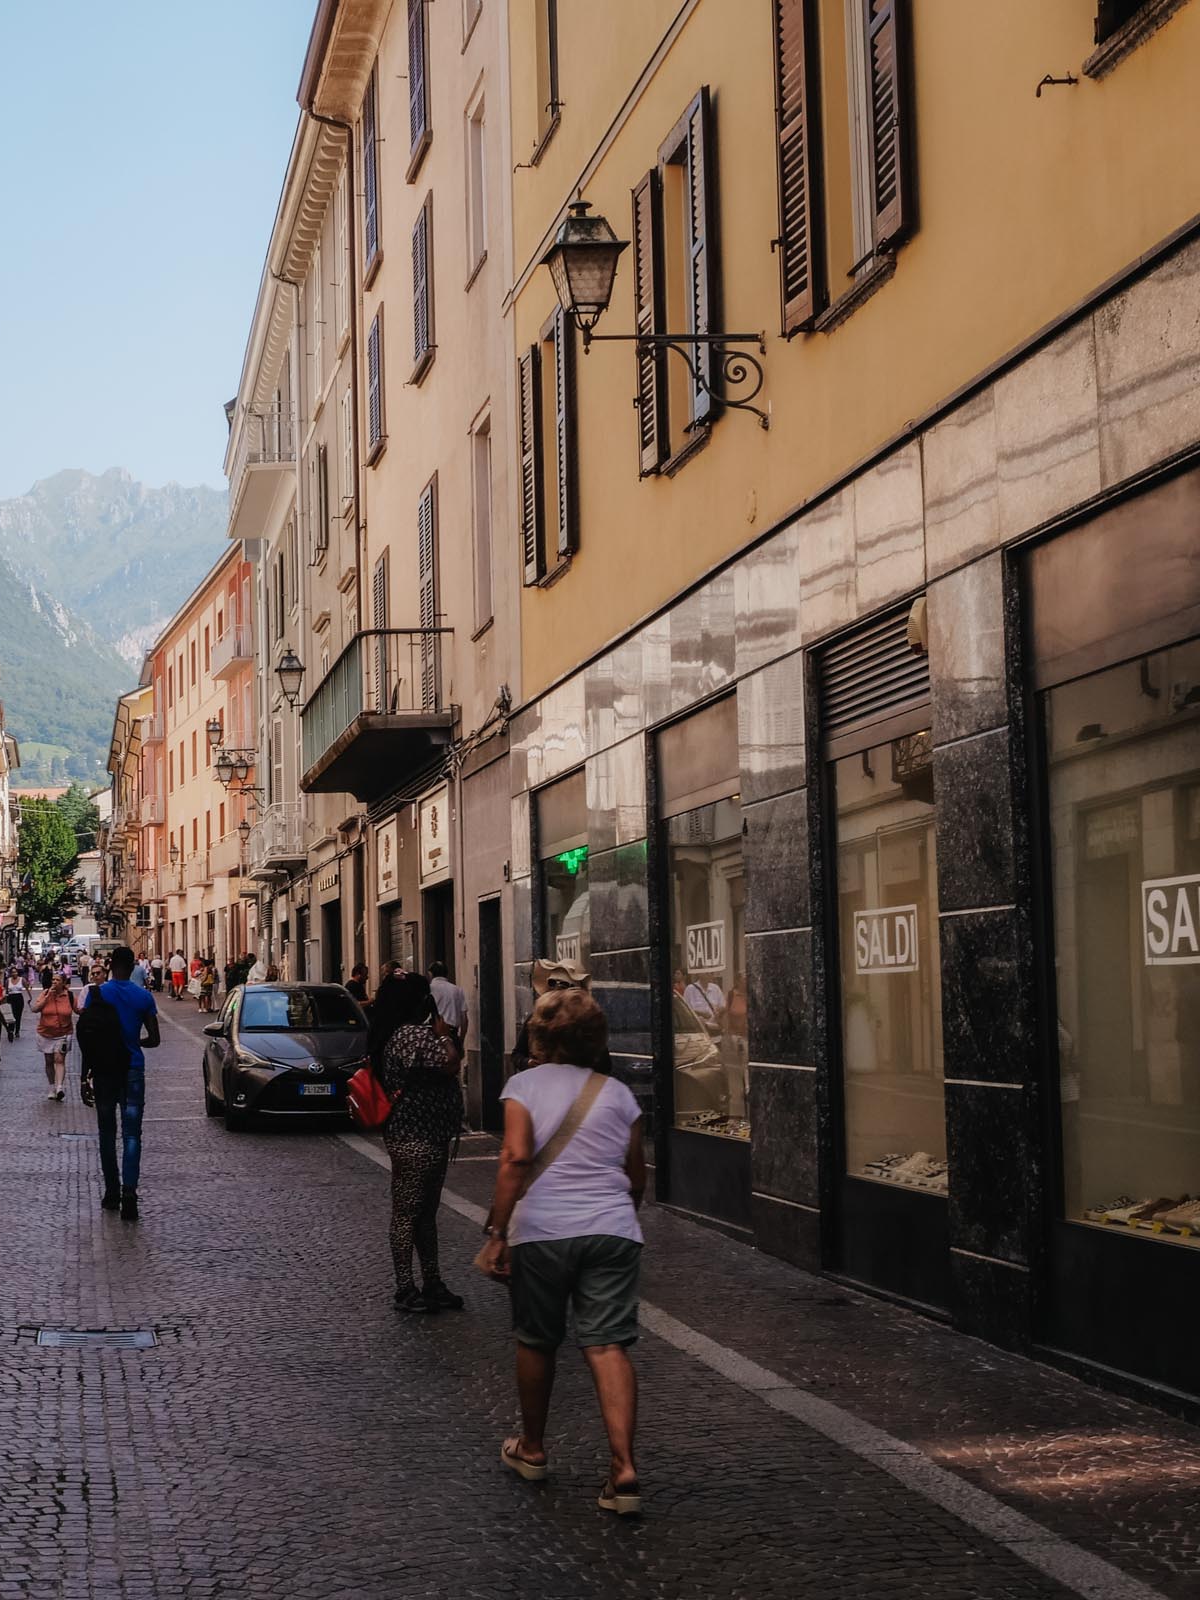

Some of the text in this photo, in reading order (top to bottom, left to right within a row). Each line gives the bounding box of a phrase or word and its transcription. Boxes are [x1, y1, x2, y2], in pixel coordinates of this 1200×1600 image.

[856, 914, 916, 968] SALDI
[1147, 886, 1200, 954] SA
[687, 927, 724, 968] SALDI
